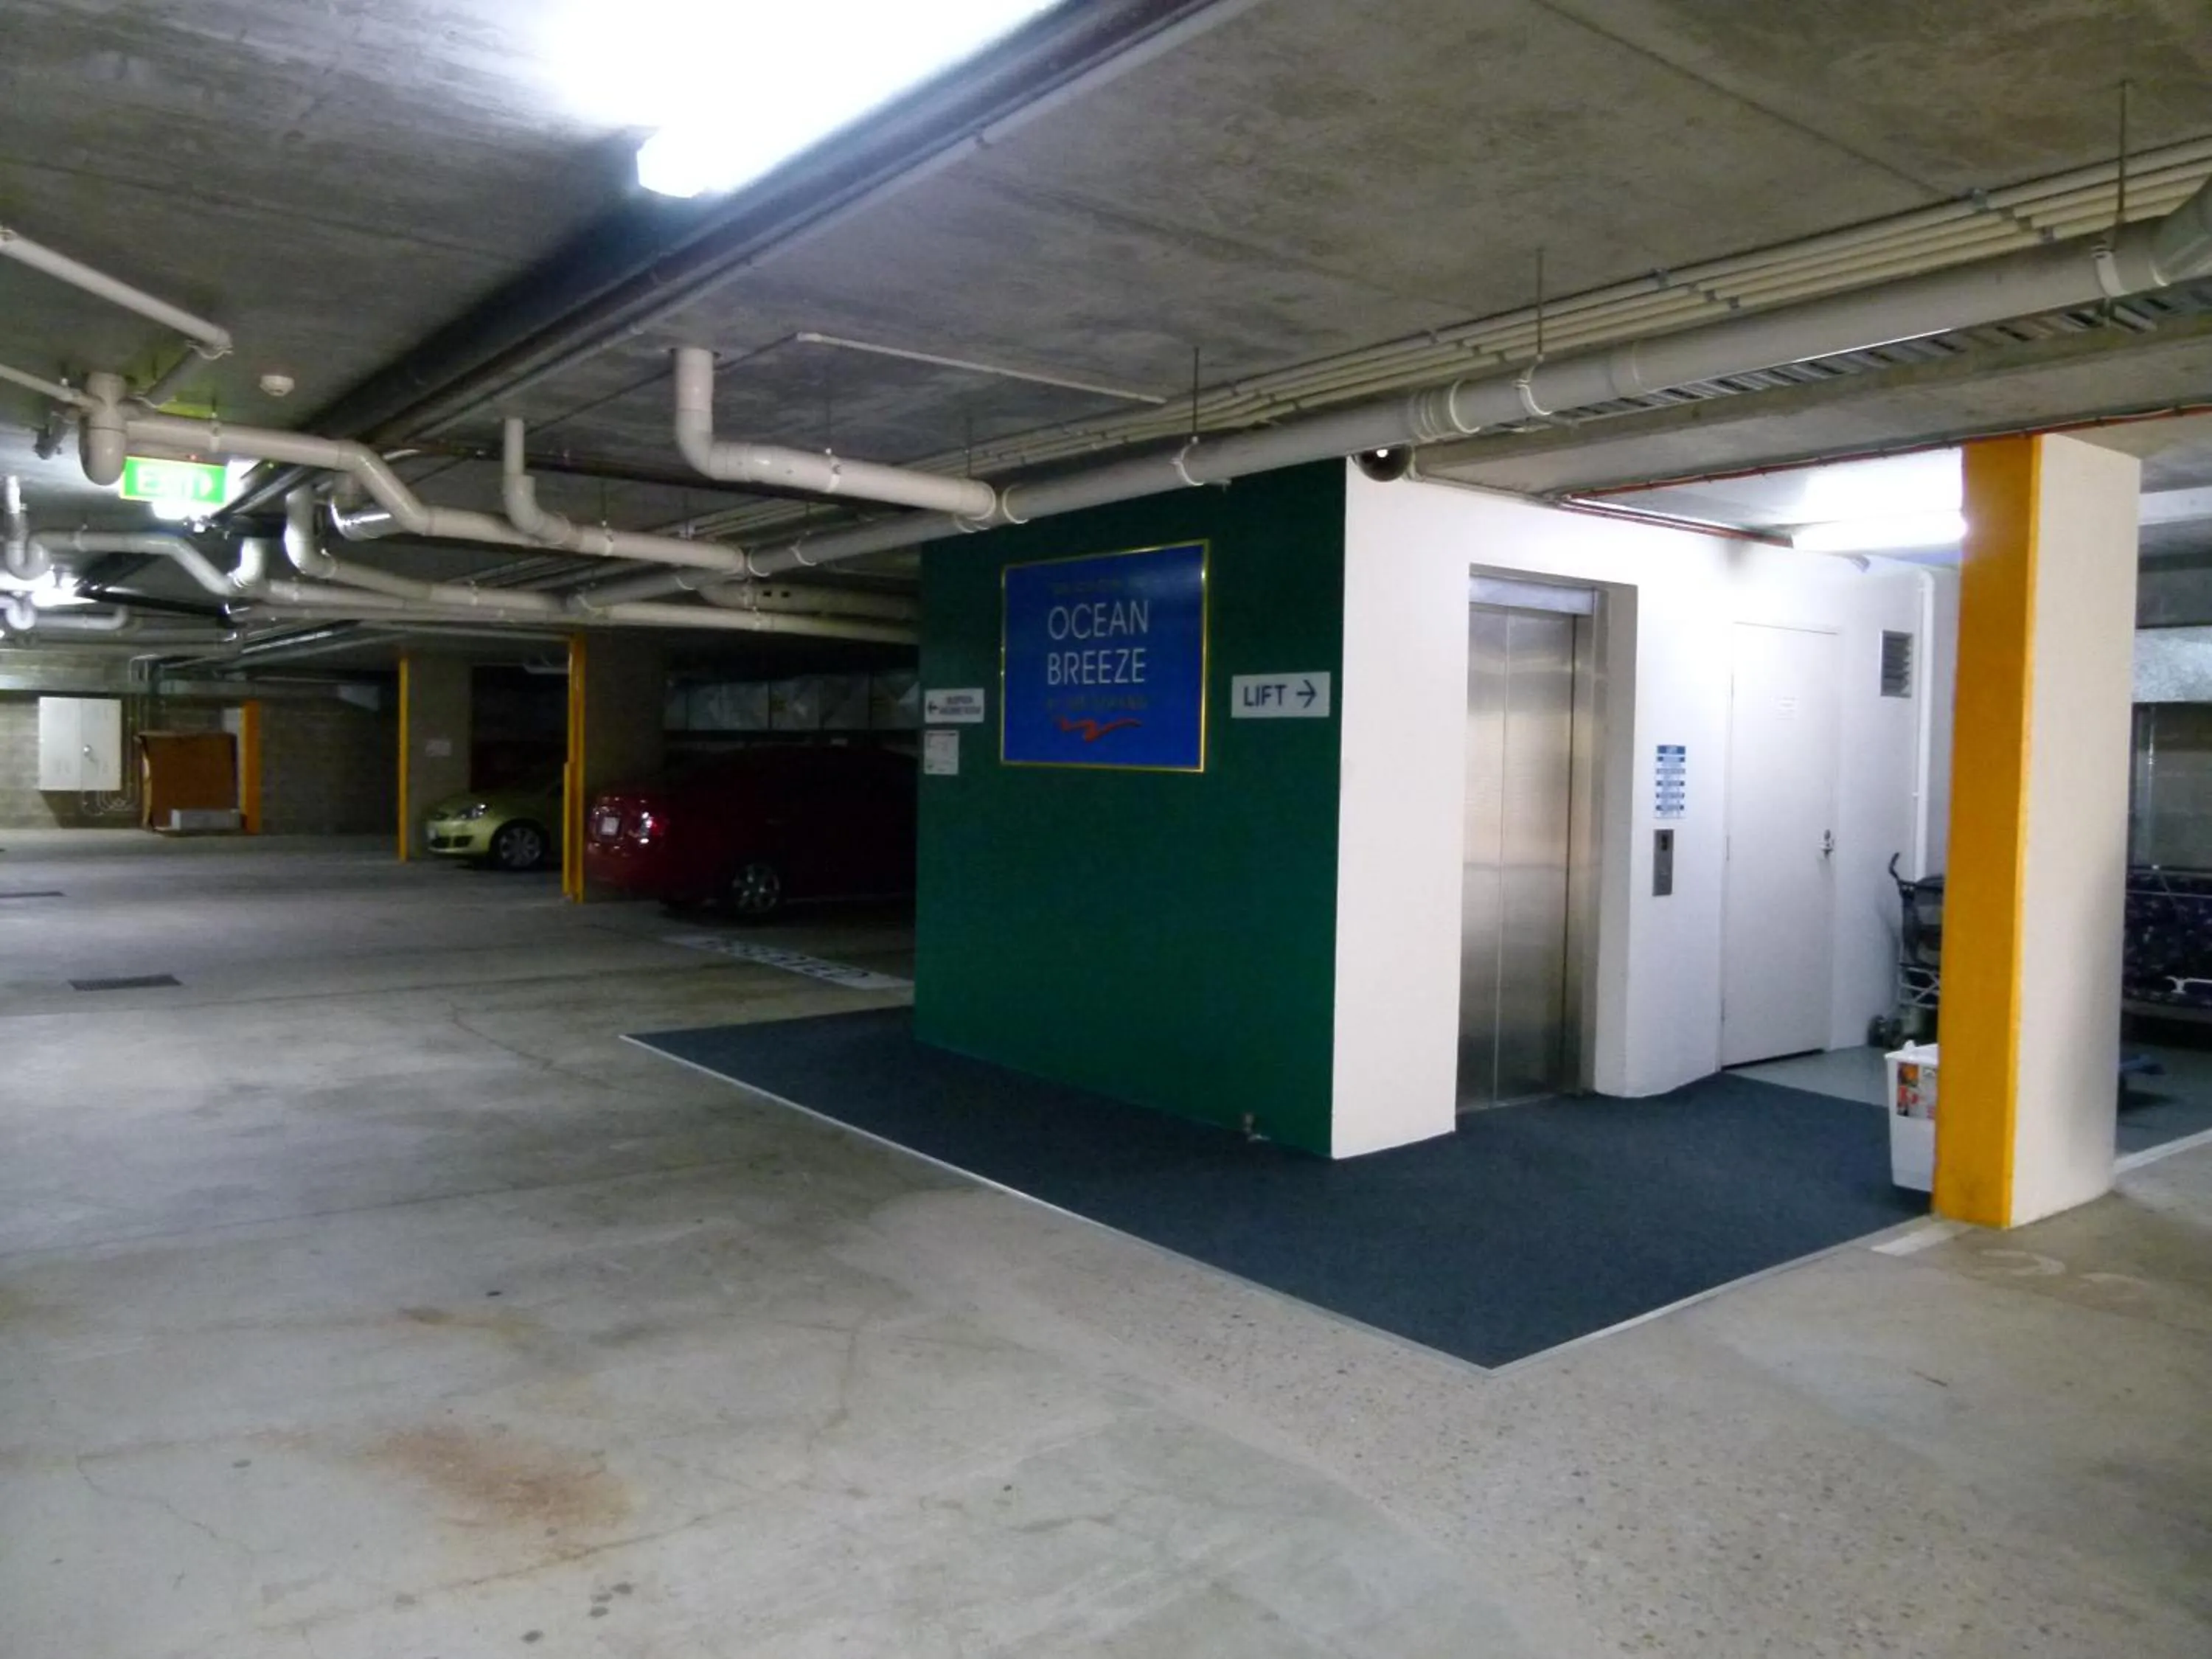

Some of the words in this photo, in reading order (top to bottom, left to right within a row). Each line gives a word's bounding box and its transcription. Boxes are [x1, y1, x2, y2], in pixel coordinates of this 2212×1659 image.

[1048, 599, 1149, 640] OCEAN
[1047, 647, 1147, 686] BREEZE
[1243, 684, 1287, 707] LIFT
